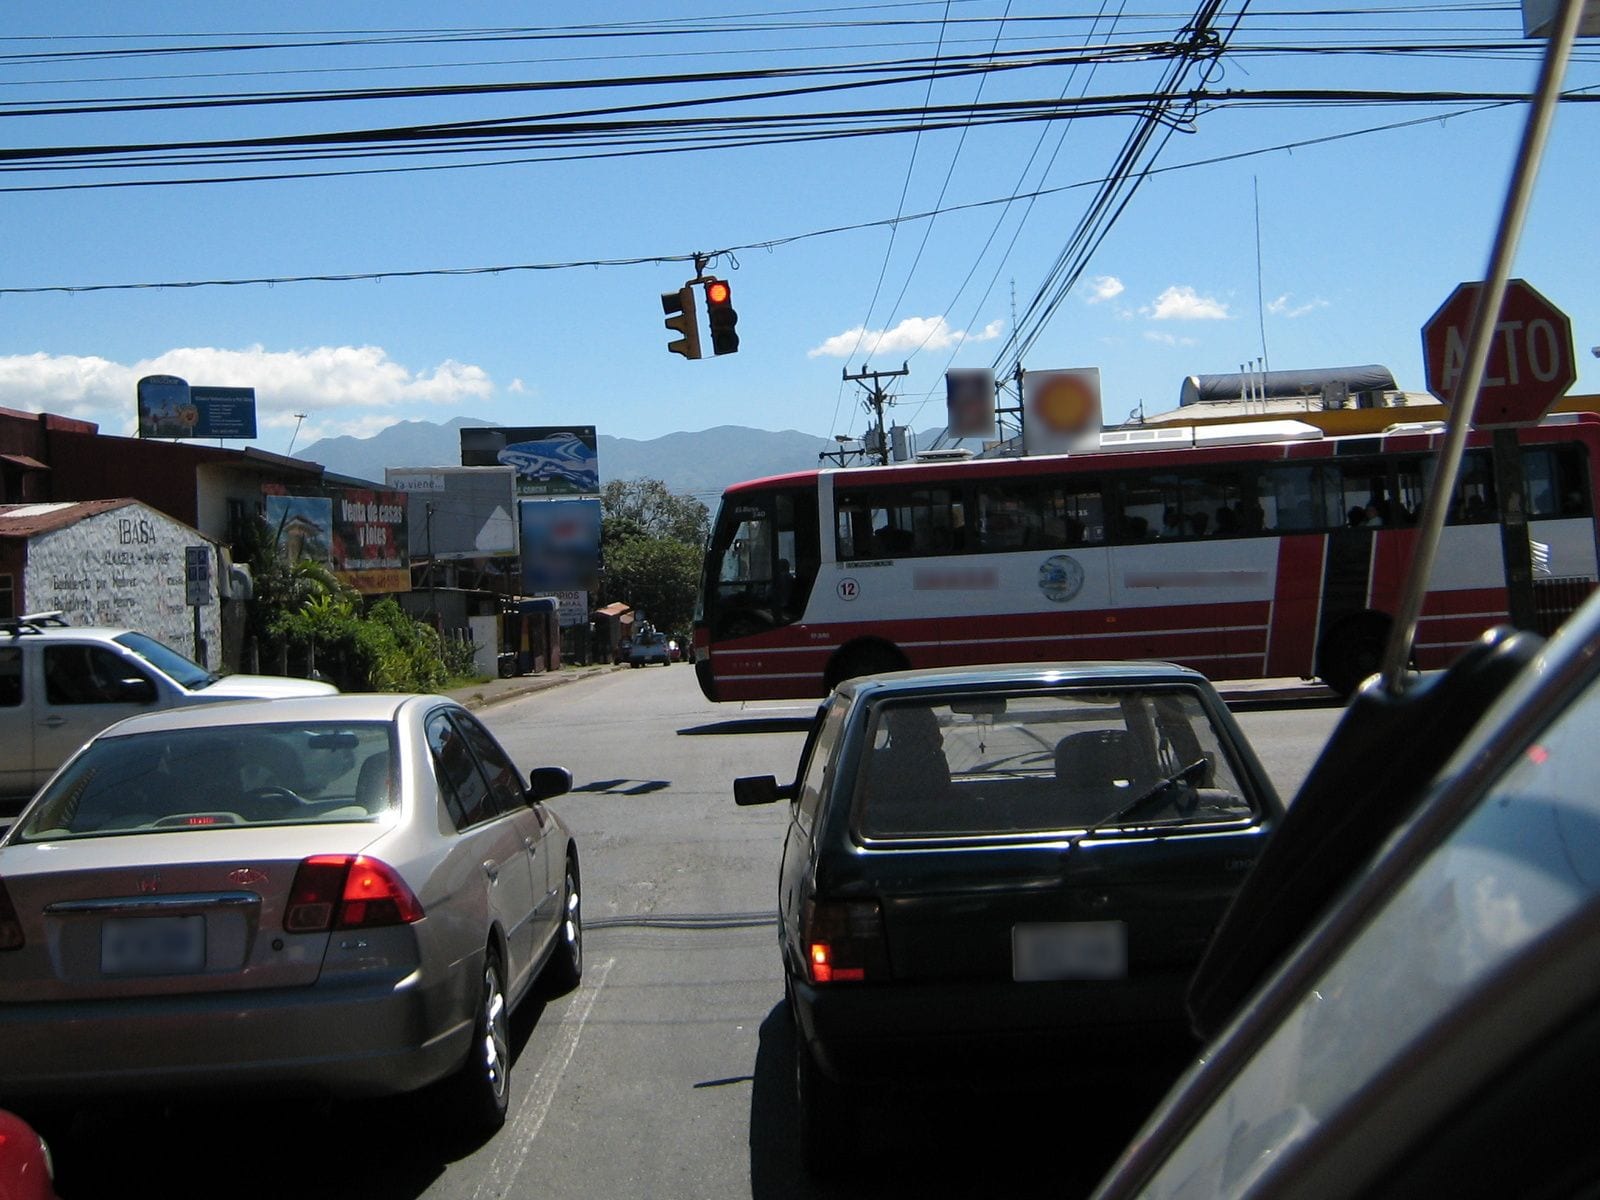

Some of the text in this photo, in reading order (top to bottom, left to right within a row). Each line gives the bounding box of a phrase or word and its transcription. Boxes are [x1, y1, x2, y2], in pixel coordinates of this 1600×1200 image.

[393, 479, 405, 489] Ya
[342, 500, 402, 523] Venta de casas
[119, 519, 156, 545] IBASA
[360, 523, 387, 547] y lotes
[841, 583, 855, 595] 12
